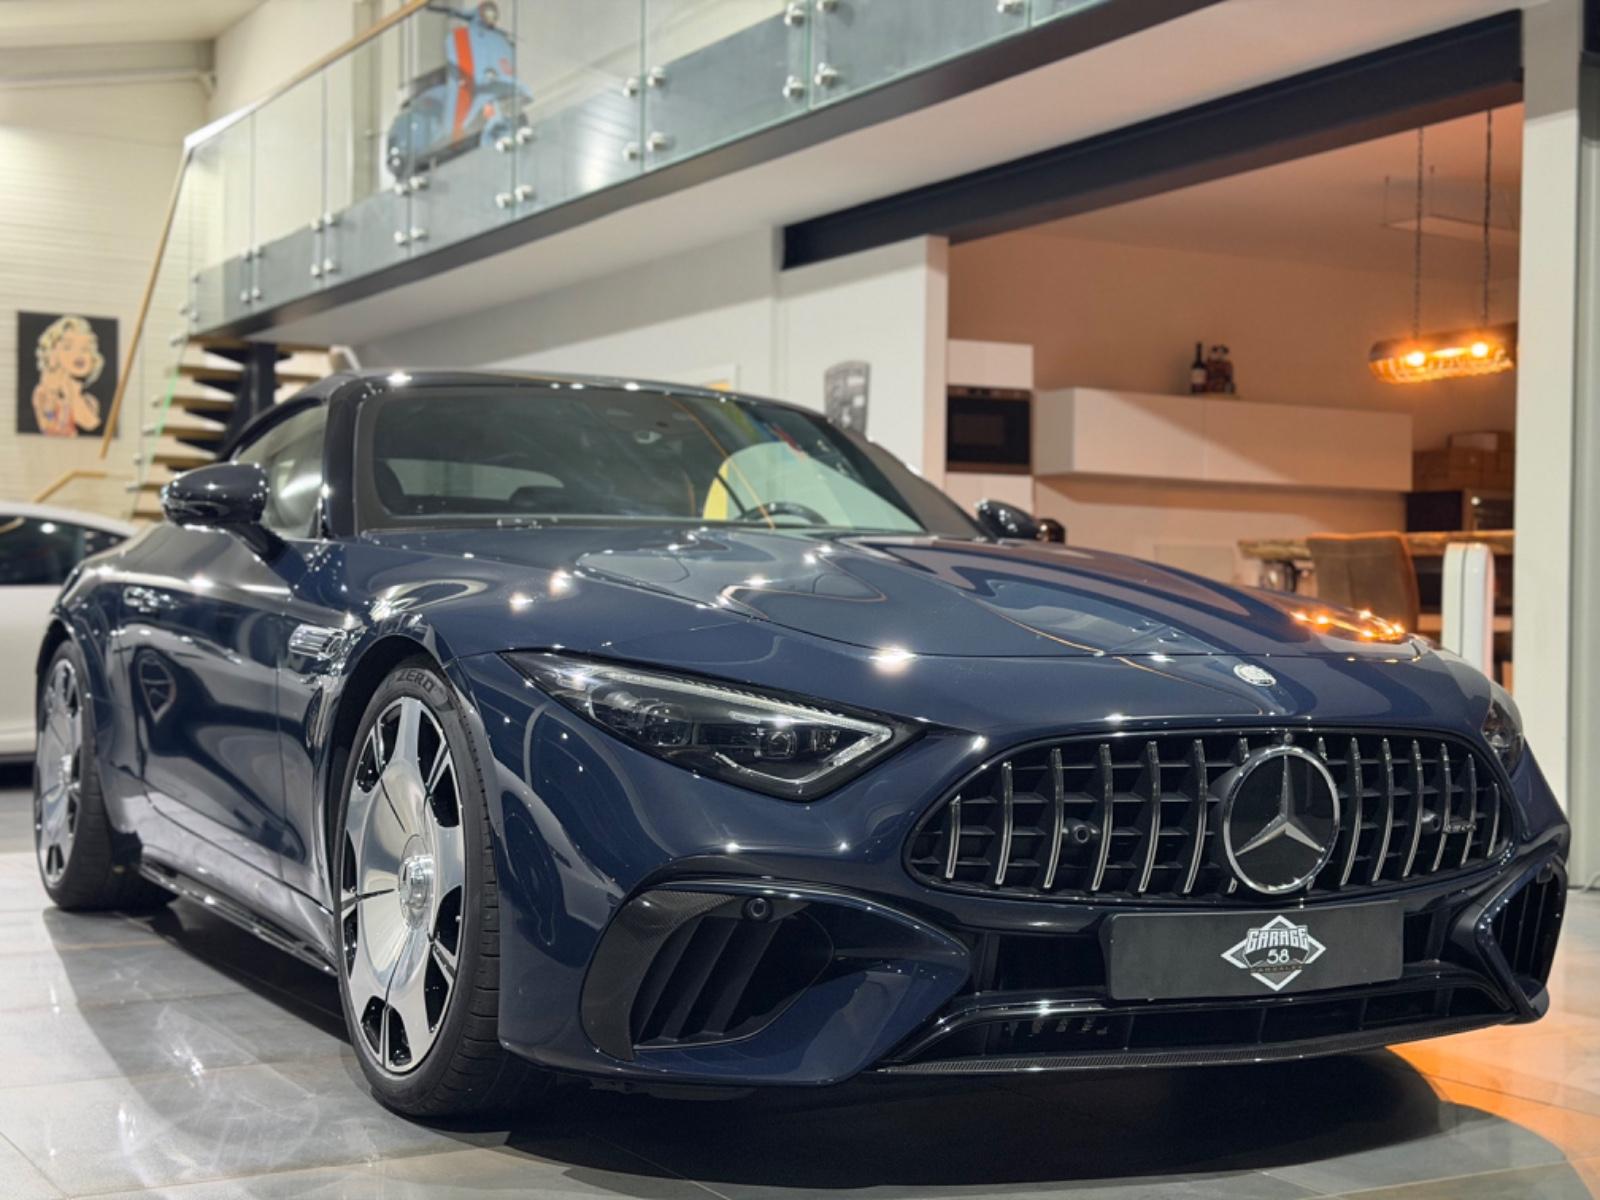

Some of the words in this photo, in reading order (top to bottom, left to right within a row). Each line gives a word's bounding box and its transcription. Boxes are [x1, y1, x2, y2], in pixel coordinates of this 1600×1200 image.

[396, 669, 434, 693] ZERO
[1246, 927, 1308, 954] GARAGE
[1266, 948, 1290, 964] 58
